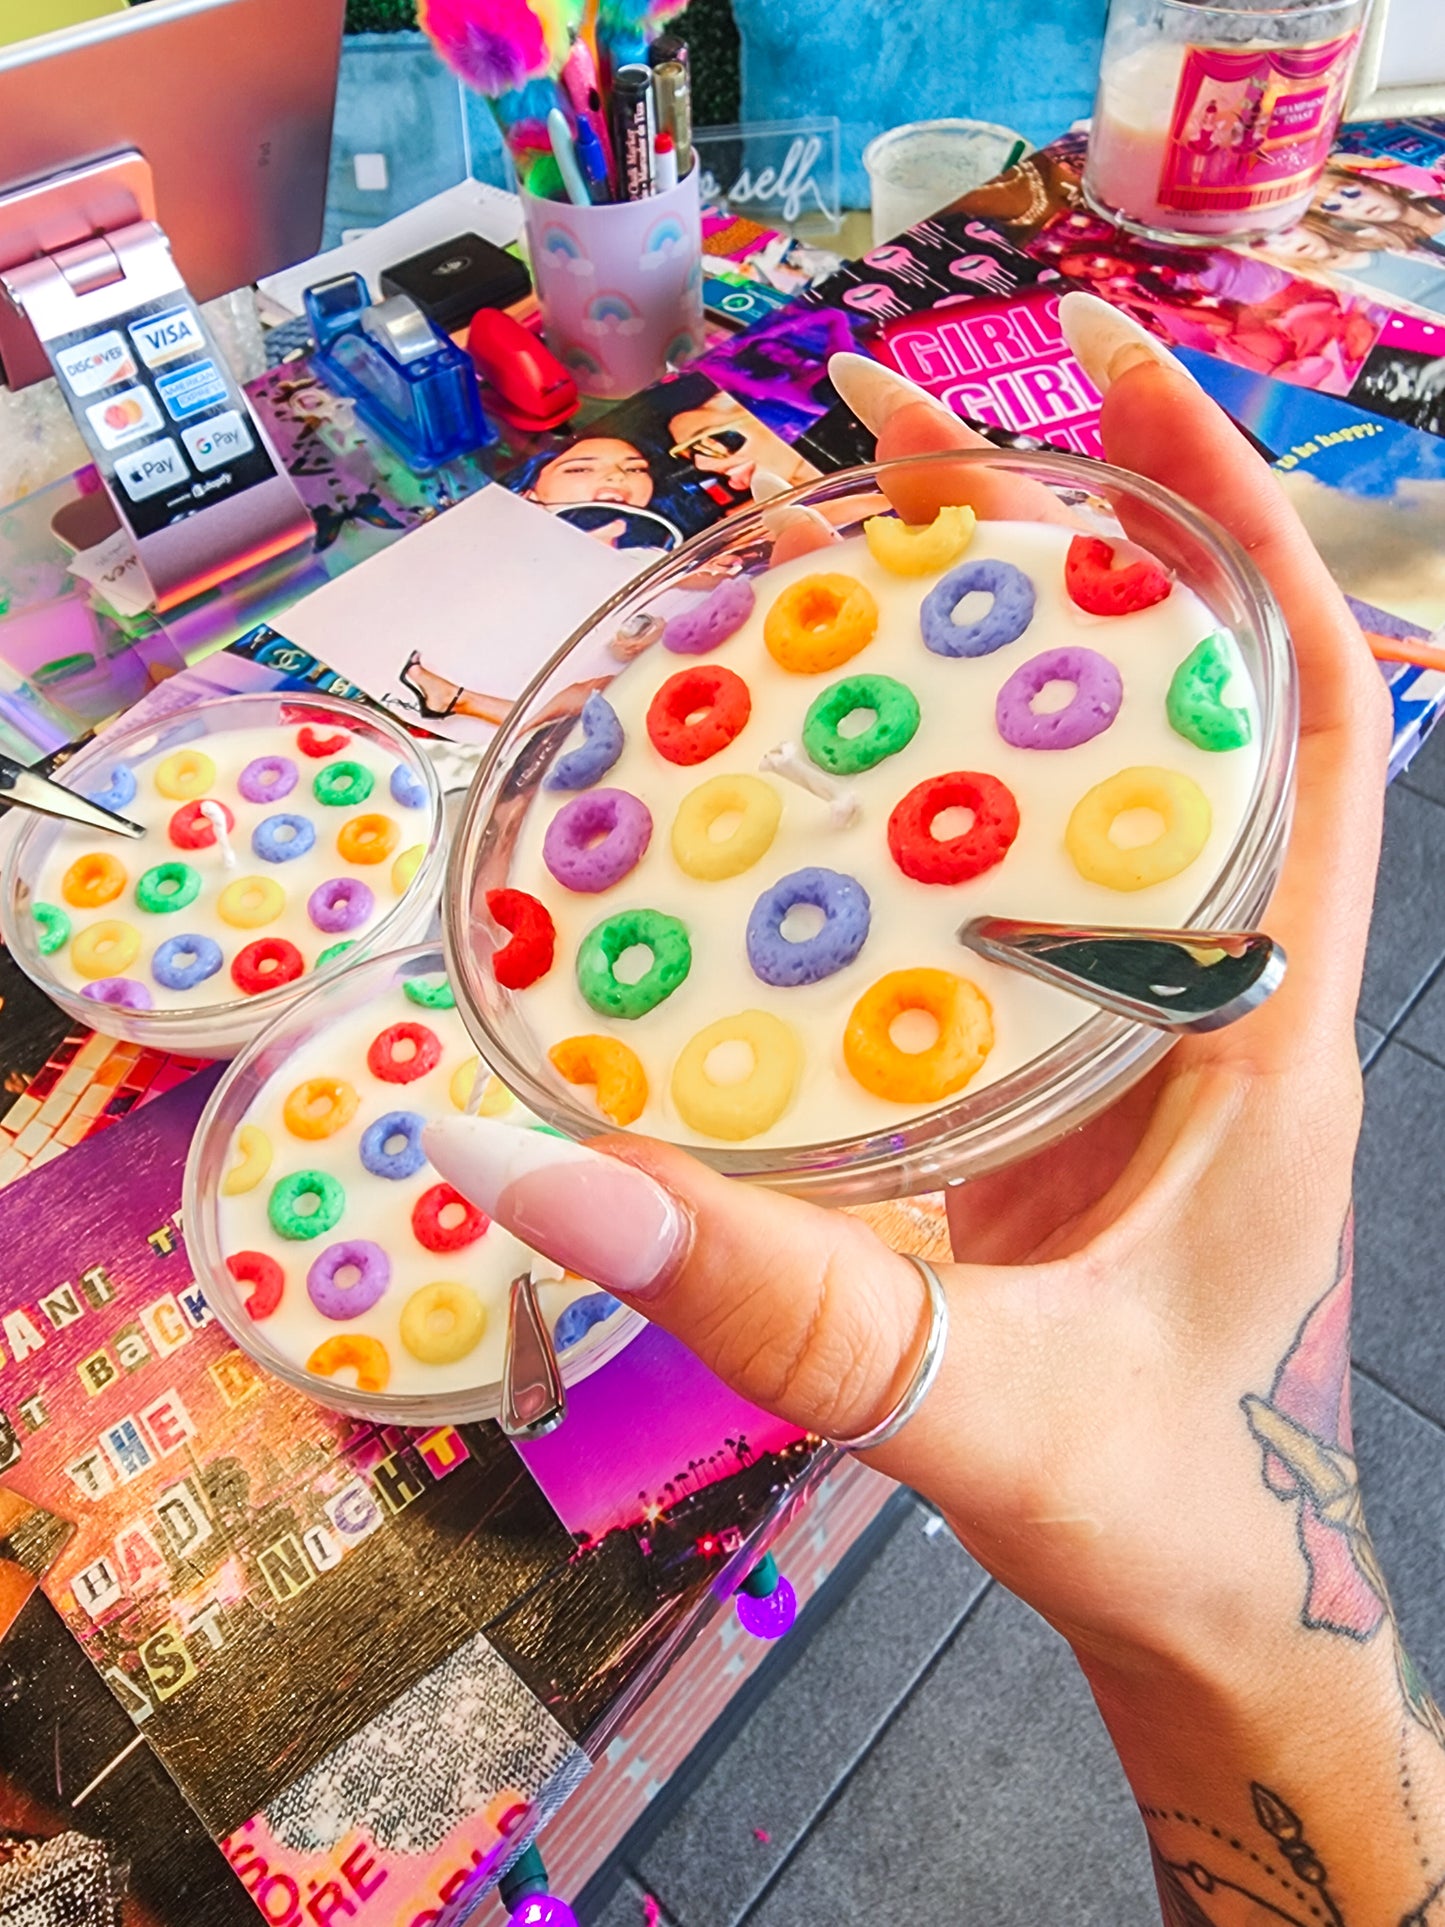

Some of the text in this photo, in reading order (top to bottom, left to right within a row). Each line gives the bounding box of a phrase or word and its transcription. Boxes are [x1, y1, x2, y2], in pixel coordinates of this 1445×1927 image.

[728, 137, 845, 222] self
[66, 346, 123, 377] DISCOVER
[145, 320, 192, 349] VISA
[163, 371, 215, 396] AMERICAN
[212, 431, 239, 449] Pay
[1, 1267, 112, 1363] ANT
[71, 1403, 186, 1491] THE
[79, 1498, 199, 1603] HAD
[264, 1425, 457, 1601] NIGHT
[305, 1842, 388, 1927] RE
